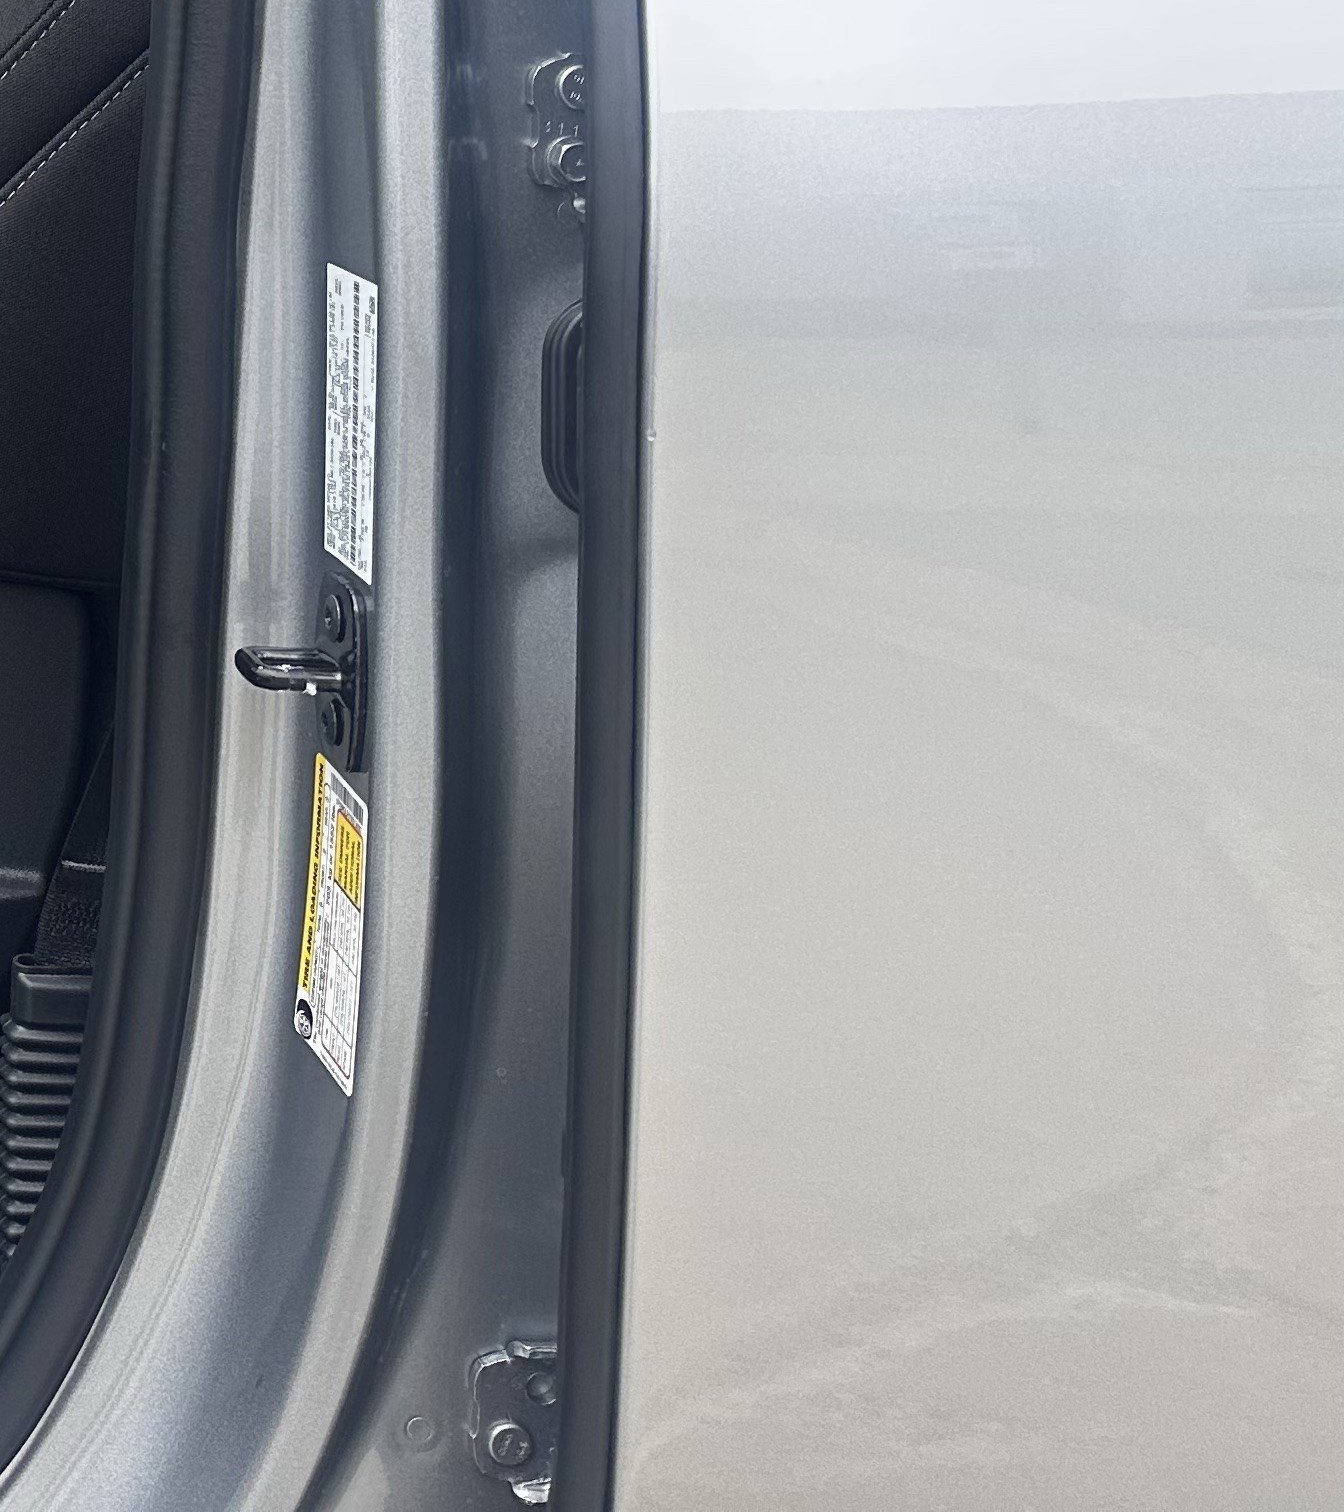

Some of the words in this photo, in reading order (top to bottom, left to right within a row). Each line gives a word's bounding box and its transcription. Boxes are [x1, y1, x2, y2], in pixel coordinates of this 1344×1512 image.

[302, 957, 310, 989] TIRE
[309, 862, 319, 922] LOADING
[314, 763, 324, 859] INFORMATION
